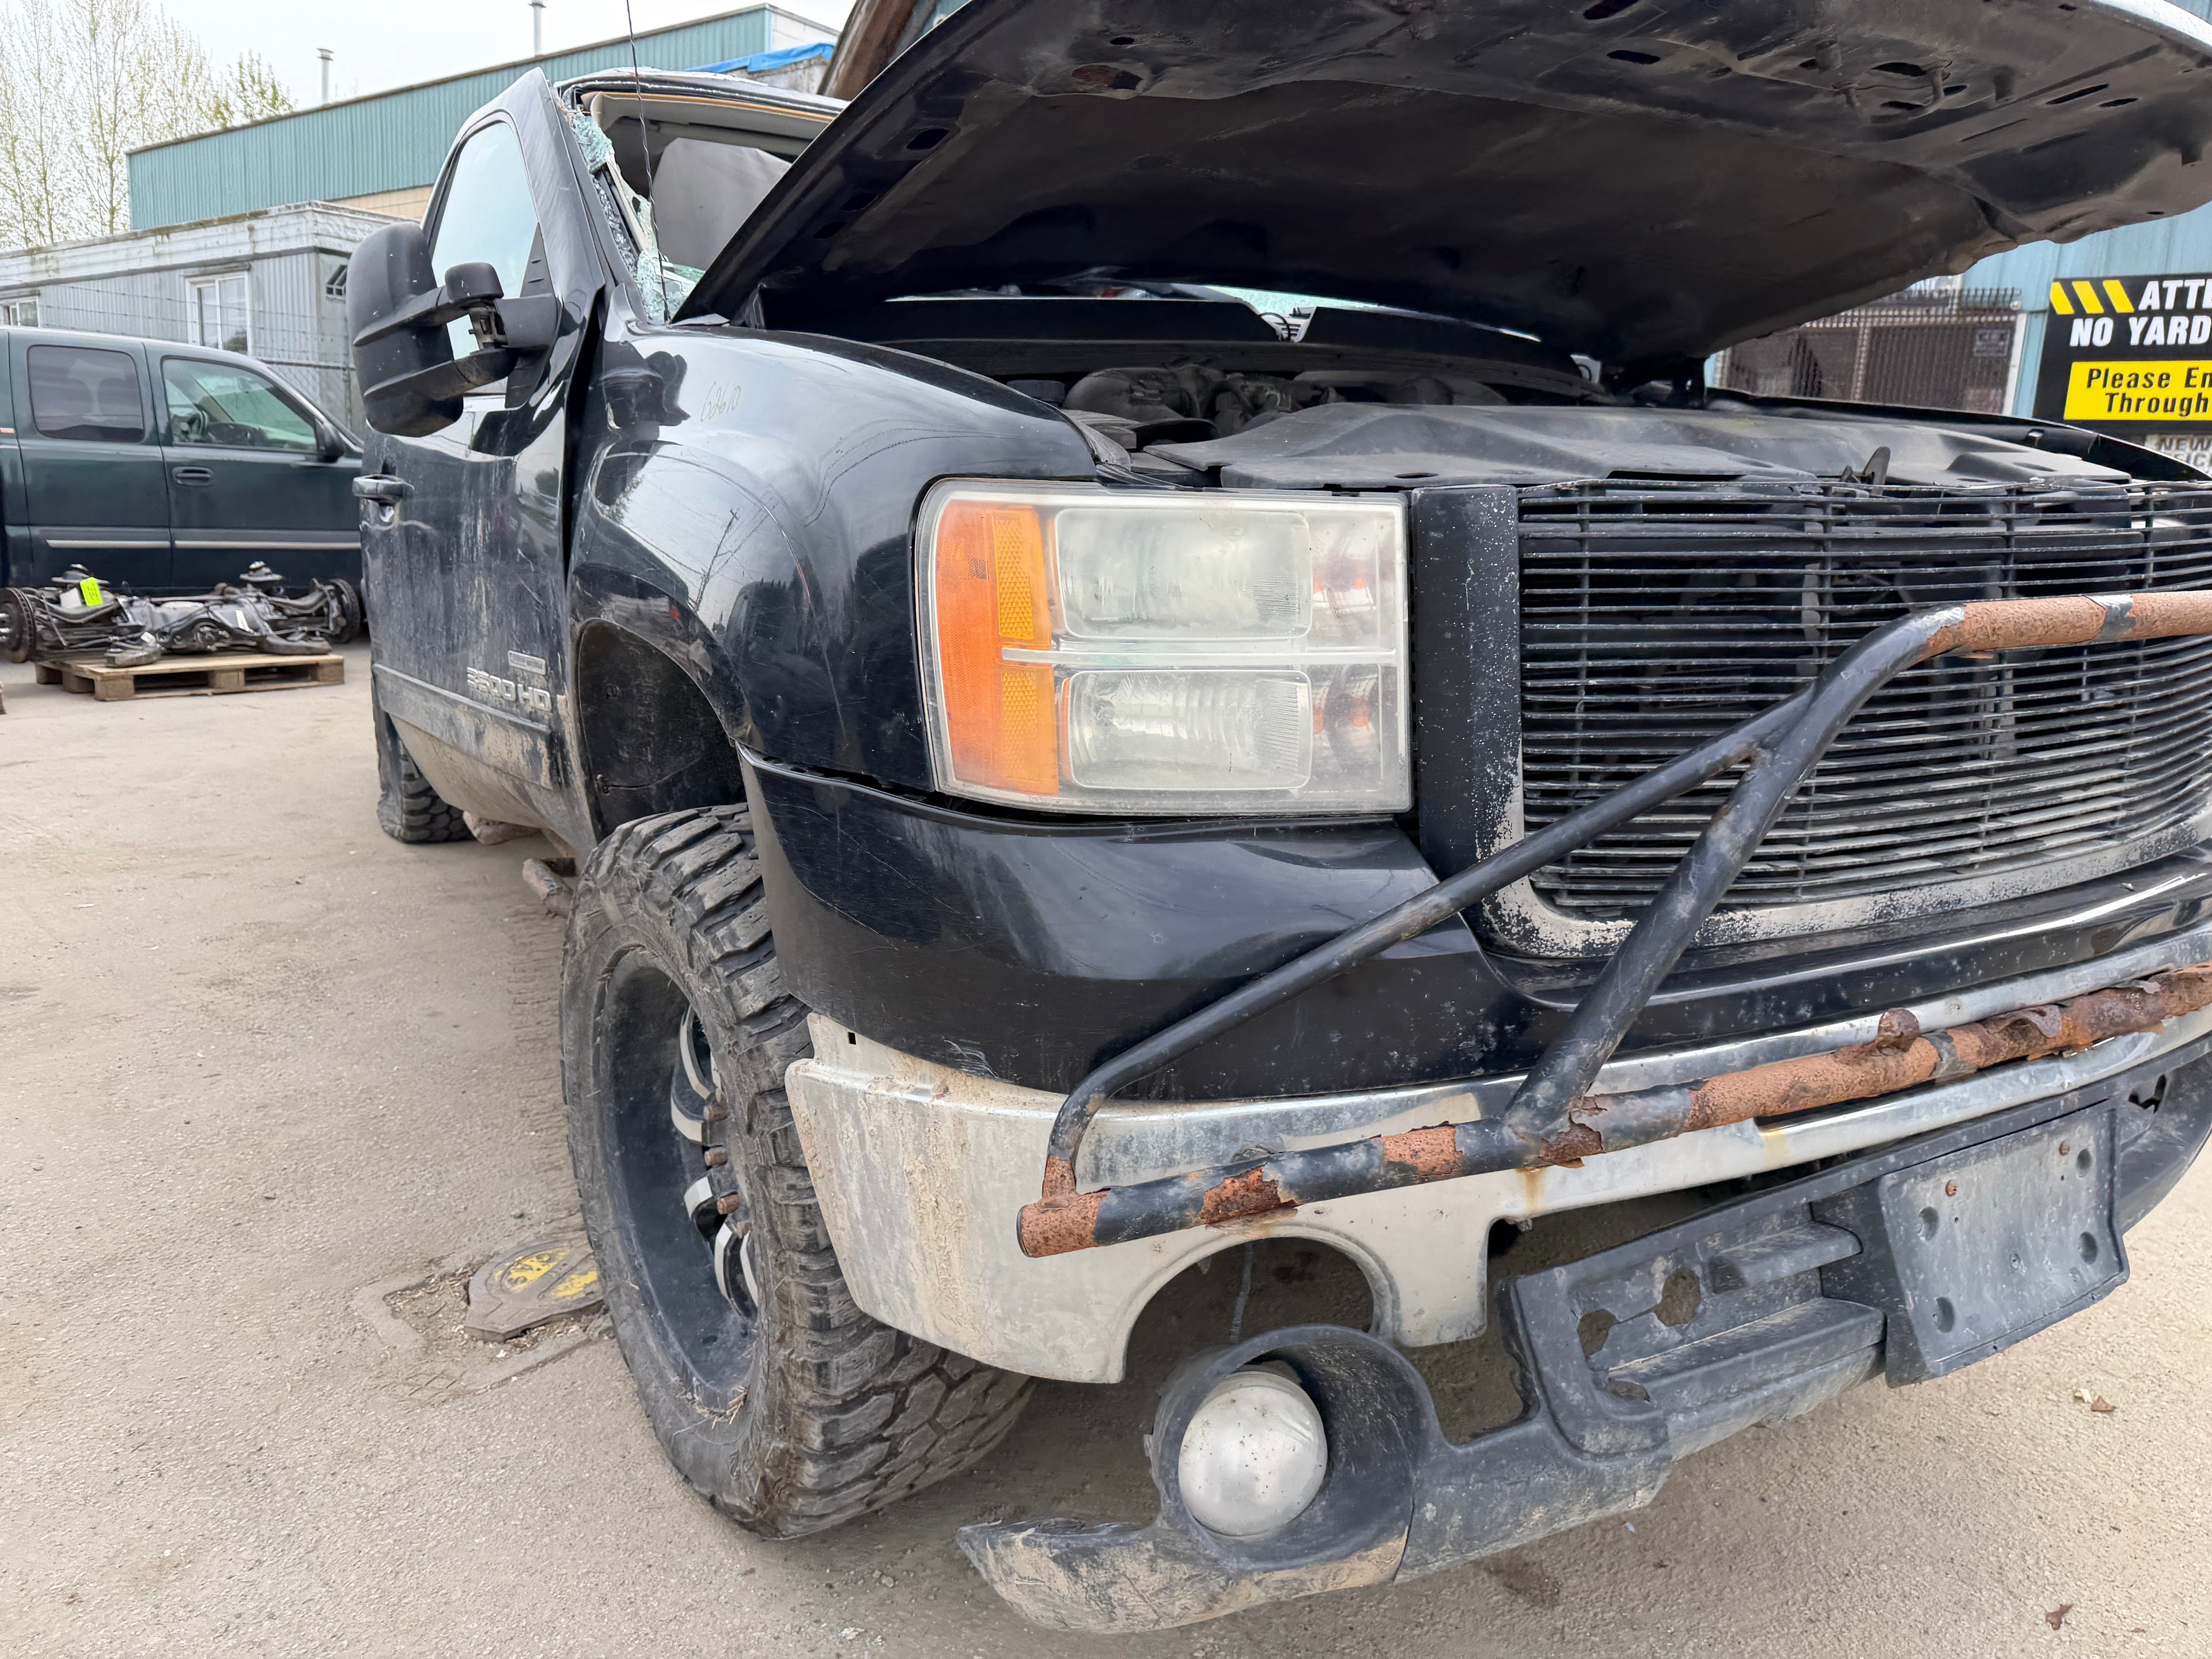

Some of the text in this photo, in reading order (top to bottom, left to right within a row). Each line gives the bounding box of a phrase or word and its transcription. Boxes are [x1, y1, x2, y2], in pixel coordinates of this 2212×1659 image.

[2070, 315, 2212, 347] NO YARD
[2086, 368, 2172, 389] Please
[2105, 392, 2210, 417] Through
